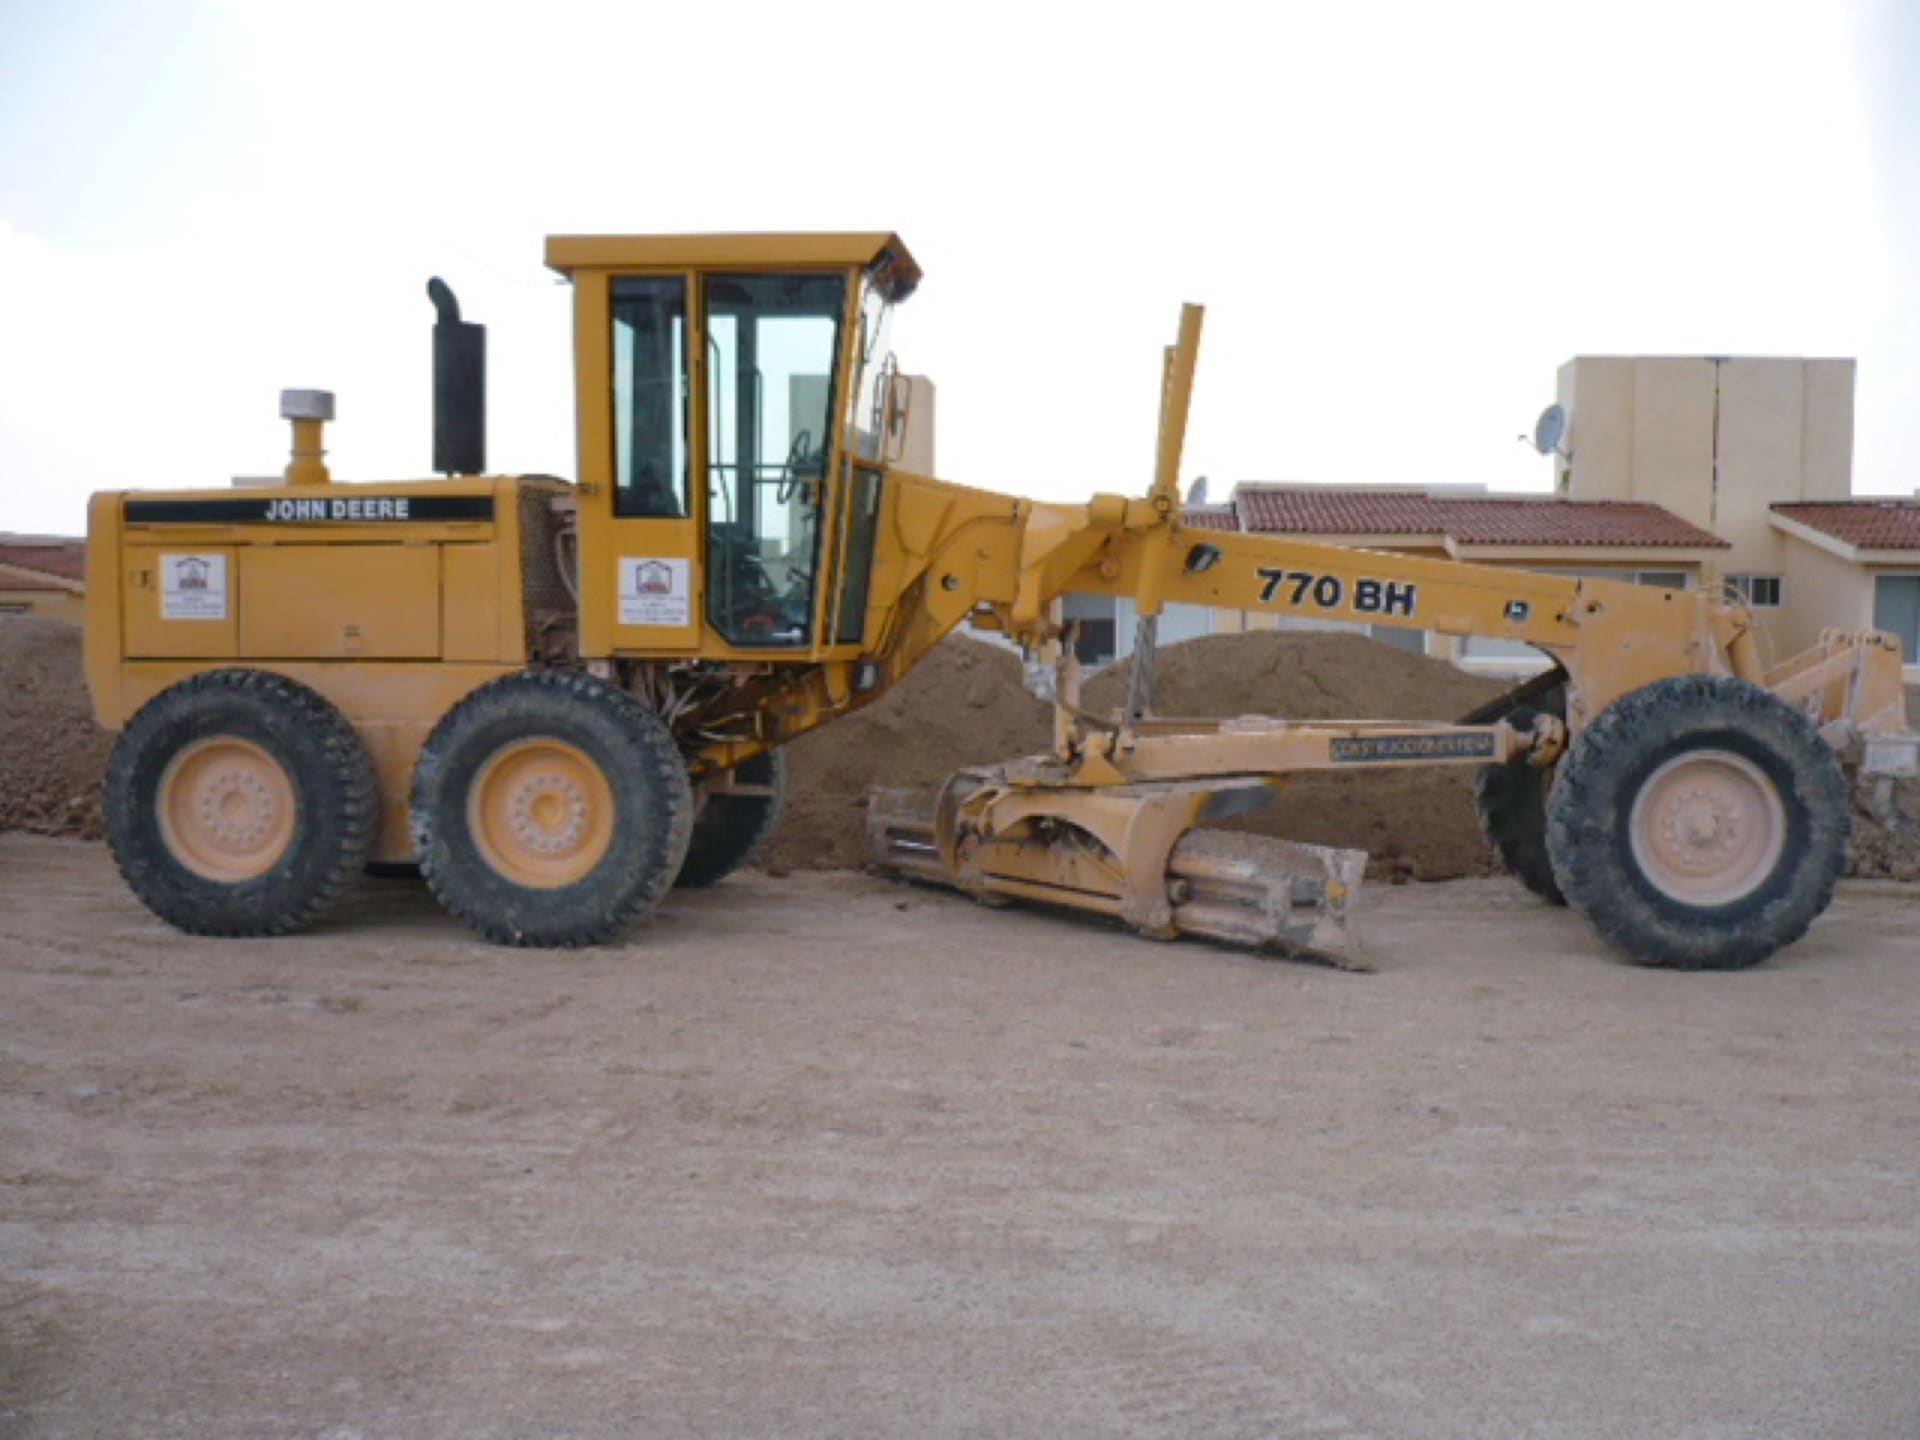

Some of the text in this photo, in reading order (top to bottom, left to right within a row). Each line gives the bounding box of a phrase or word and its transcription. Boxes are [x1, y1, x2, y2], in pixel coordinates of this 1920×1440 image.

[265, 497, 410, 521] JOHN DEERE
[1256, 567, 1418, 617] 770 BH
